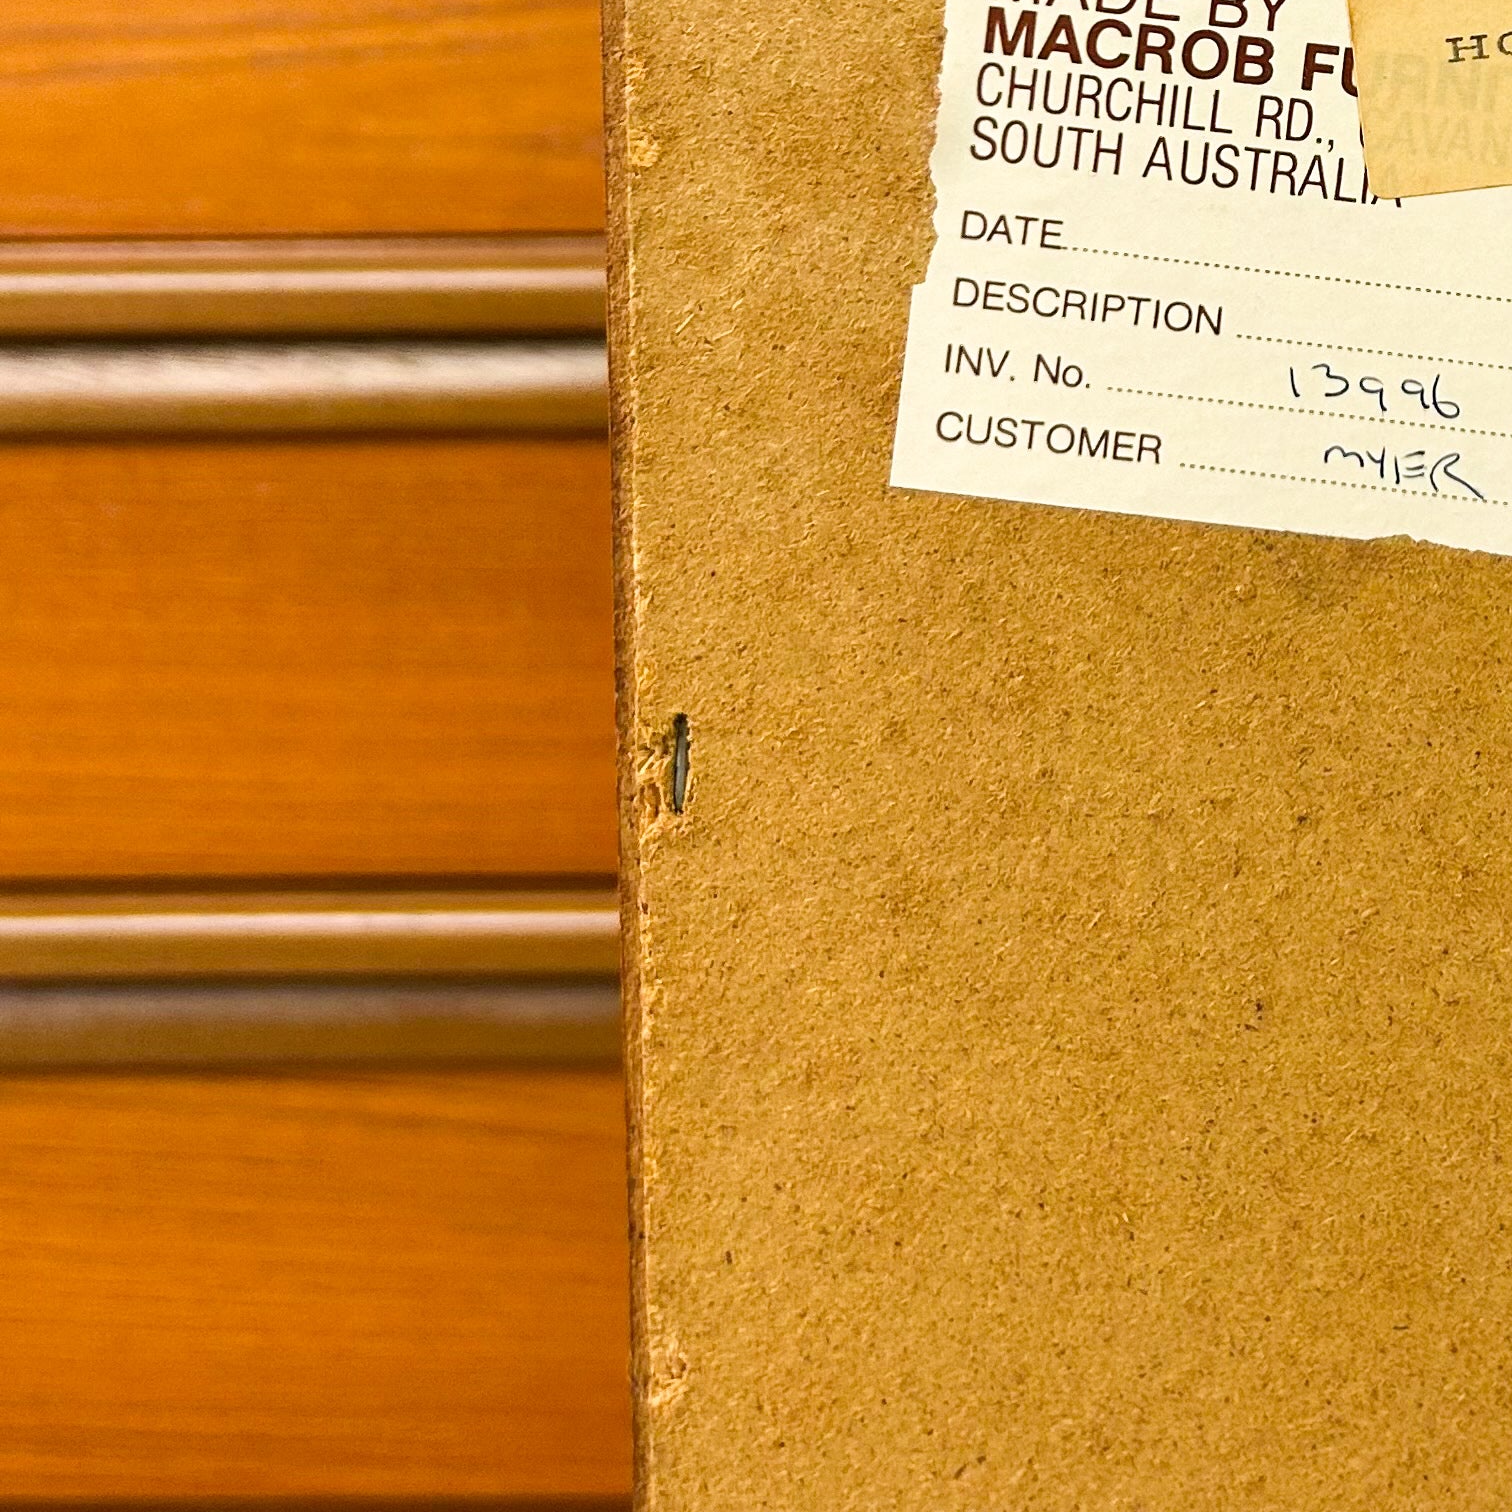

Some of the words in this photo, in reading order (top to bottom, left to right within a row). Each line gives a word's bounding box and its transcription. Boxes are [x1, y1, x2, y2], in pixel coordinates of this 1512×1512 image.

[983, 6, 1275, 85] MACROB
[976, 61, 1233, 134] CHURCHILL
[970, 115, 1124, 175] SOUTH
[960, 209, 1064, 250] DATE
[952, 276, 1224, 337] DESCRIPTION
[944, 343, 1016, 384] INV.
[1033, 354, 1093, 391] No.
[934, 410, 1163, 466] CUSTOMER
